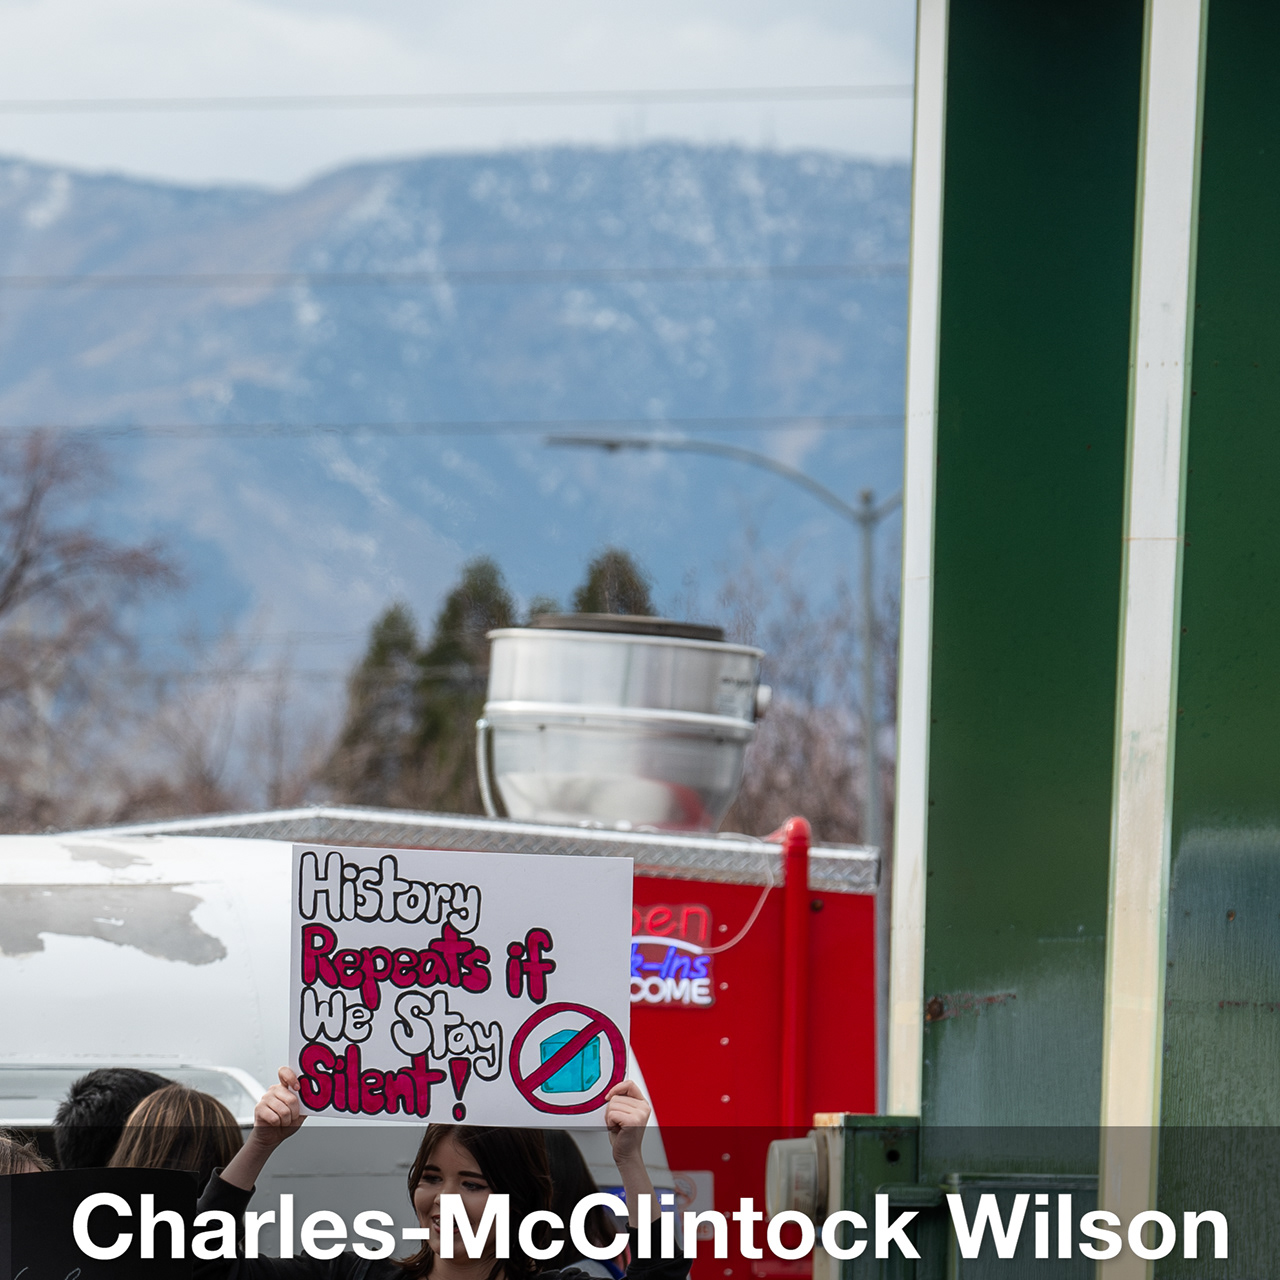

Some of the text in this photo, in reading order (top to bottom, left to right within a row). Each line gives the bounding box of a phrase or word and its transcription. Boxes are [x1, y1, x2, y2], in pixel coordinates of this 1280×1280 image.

[299, 851, 482, 934] History
[300, 923, 556, 1009] Repeats if
[301, 986, 503, 1080] We Stay
[299, 1042, 471, 1121] Silent!
